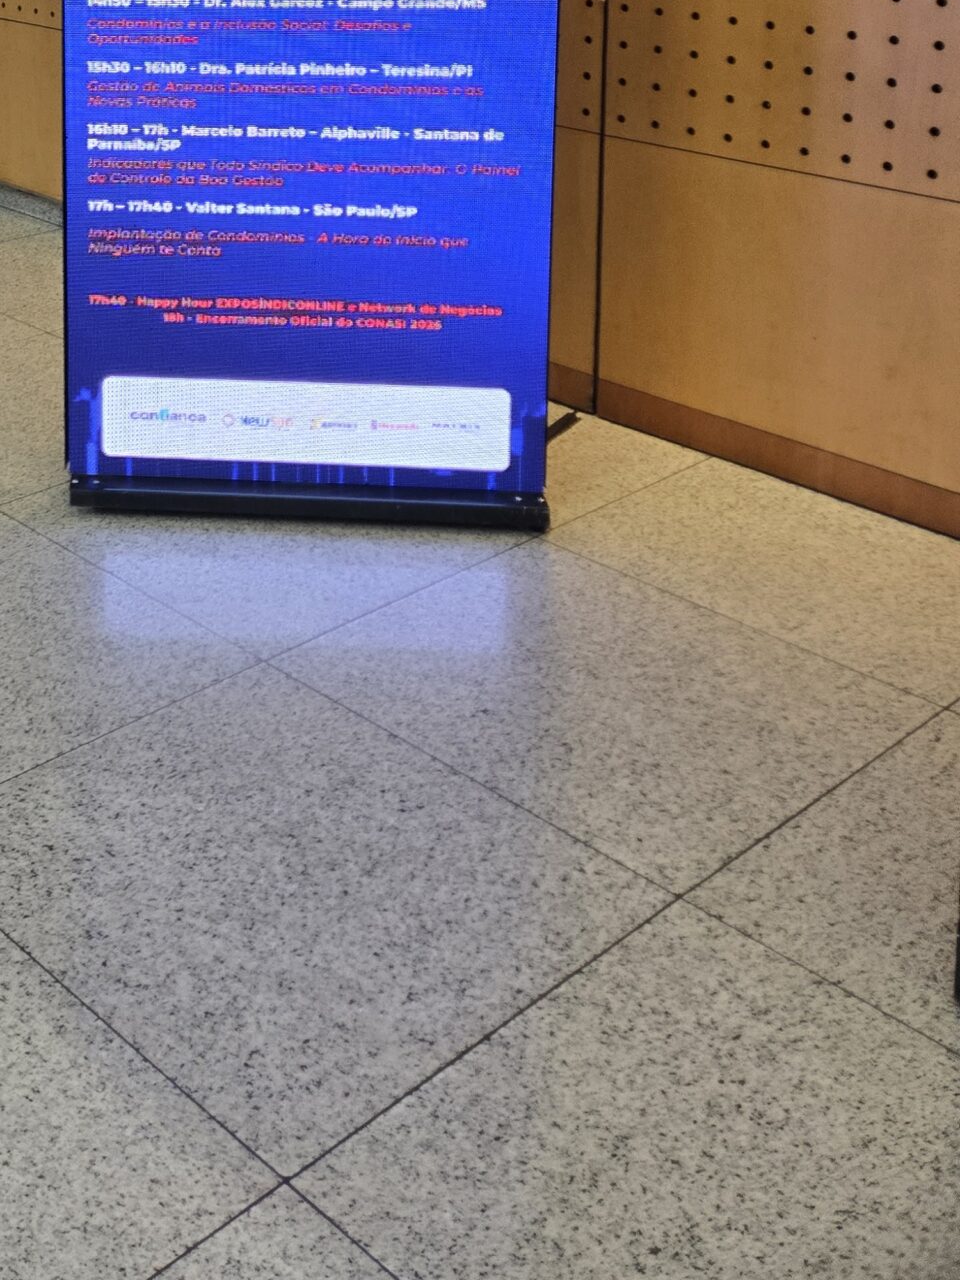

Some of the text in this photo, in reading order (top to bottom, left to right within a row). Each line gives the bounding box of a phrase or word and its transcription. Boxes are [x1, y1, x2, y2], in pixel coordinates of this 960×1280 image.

[86, 61, 130, 73] 15h30
[144, 61, 186, 74] 16h10
[199, 62, 232, 74] Dra.
[235, 62, 296, 75] Patrícia
[299, 62, 366, 76] Pinheiro
[381, 62, 473, 77] Teresina/PI
[164, 81, 225, 92] Animais
[87, 96, 132, 107] Novas
[87, 123, 128, 135] 16h10
[143, 123, 168, 135] 17h
[181, 124, 243, 137] Marcelo
[247, 126, 305, 137] Barreto
[320, 126, 400, 141] Alphaville
[413, 128, 479, 140] Santana
[483, 128, 504, 141] de
[88, 158, 173, 169] Indicadores
[176, 161, 206, 171] que
[210, 159, 244, 170] Todo
[88, 200, 114, 212] 17h
[127, 200, 173, 213] 17h40
[185, 202, 234, 214] Valter
[236, 203, 300, 215] Santana
[313, 203, 343, 216] São
[346, 204, 418, 218] Paulo/SP
[88, 228, 181, 242] Implantação
[185, 230, 203, 240] de
[440, 237, 468, 249] que
[88, 243, 222, 256] Ninguém te Conta
[89, 294, 127, 305] 17h40
[137, 296, 179, 308] Happy
[182, 297, 213, 308] Hour
[348, 303, 357, 312] e
[359, 301, 415, 313] Network
[420, 303, 436, 314] de
[164, 312, 184, 323] 18h
[196, 313, 288, 325] Encerramento
[291, 315, 332, 327] Oficial
[336, 316, 353, 327] do
[356, 318, 405, 328] CONASI
[410, 318, 442, 330] 2026
